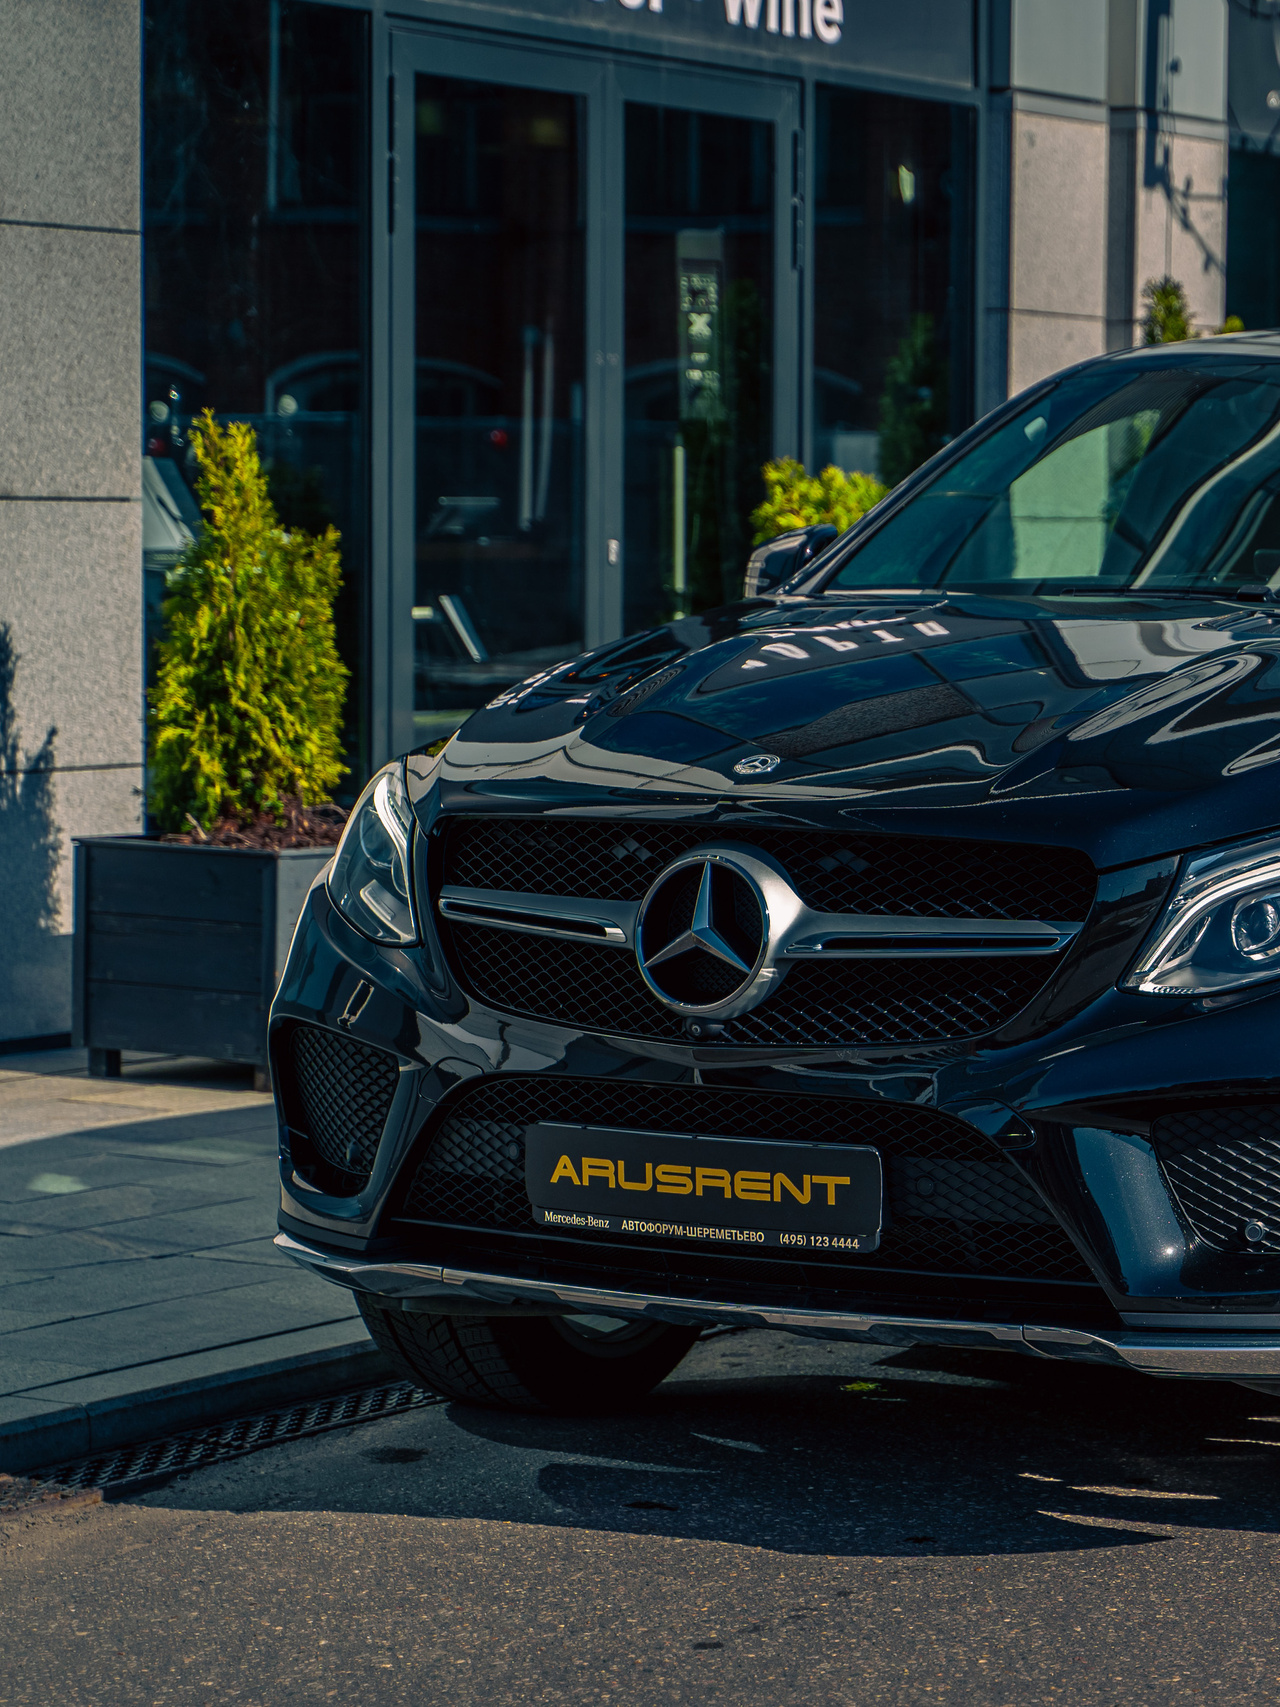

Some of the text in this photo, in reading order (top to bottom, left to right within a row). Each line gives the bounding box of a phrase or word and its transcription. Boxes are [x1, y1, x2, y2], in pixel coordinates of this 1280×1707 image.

[549, 1154, 851, 1206] ARUSRENT
[544, 1210, 610, 1229] Mercedes-Benz
[621, 1219, 765, 1243] АВТОФОРУМ-ШЕРЕМЕТЬЕВО
[779, 1233, 861, 1250] (495) 123 4444
